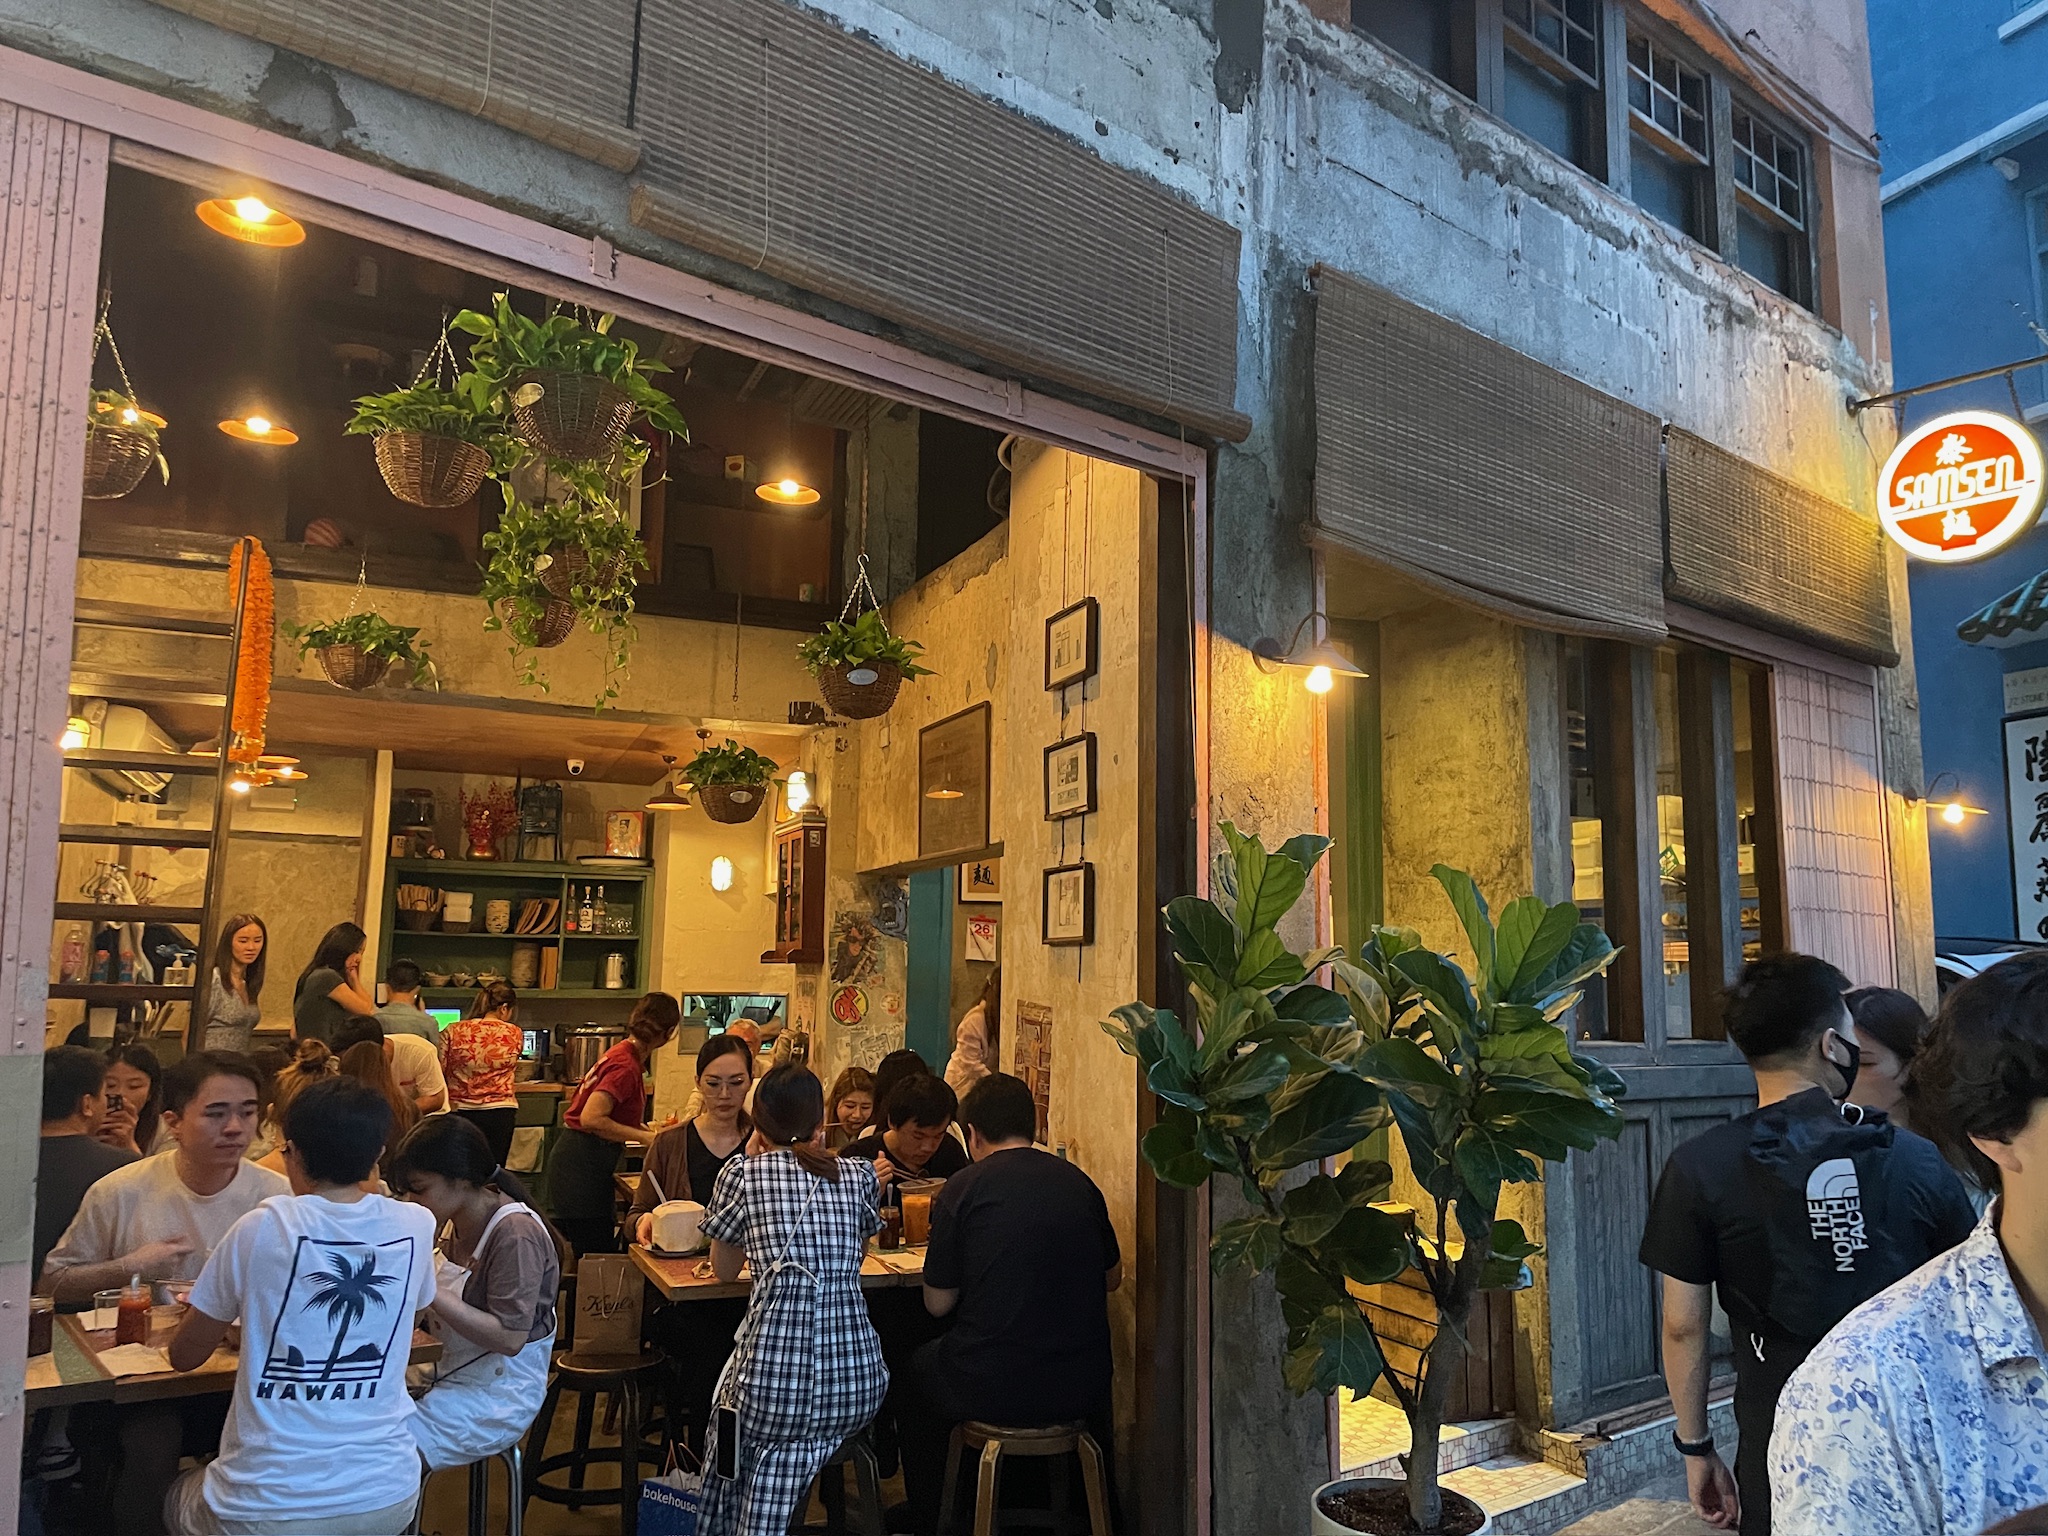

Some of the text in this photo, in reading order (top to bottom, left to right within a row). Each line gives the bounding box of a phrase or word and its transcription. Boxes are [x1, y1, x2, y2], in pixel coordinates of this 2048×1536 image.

[1895, 454, 2016, 513] SAMSEN
[974, 923, 990, 934] 26
[1807, 1200, 1831, 1240] THE
[1826, 1199, 1855, 1272] NORTH
[1843, 1197, 1869, 1250] FACE
[256, 1381, 378, 1401] HAWAII
[643, 1484, 698, 1514] bakehouse
